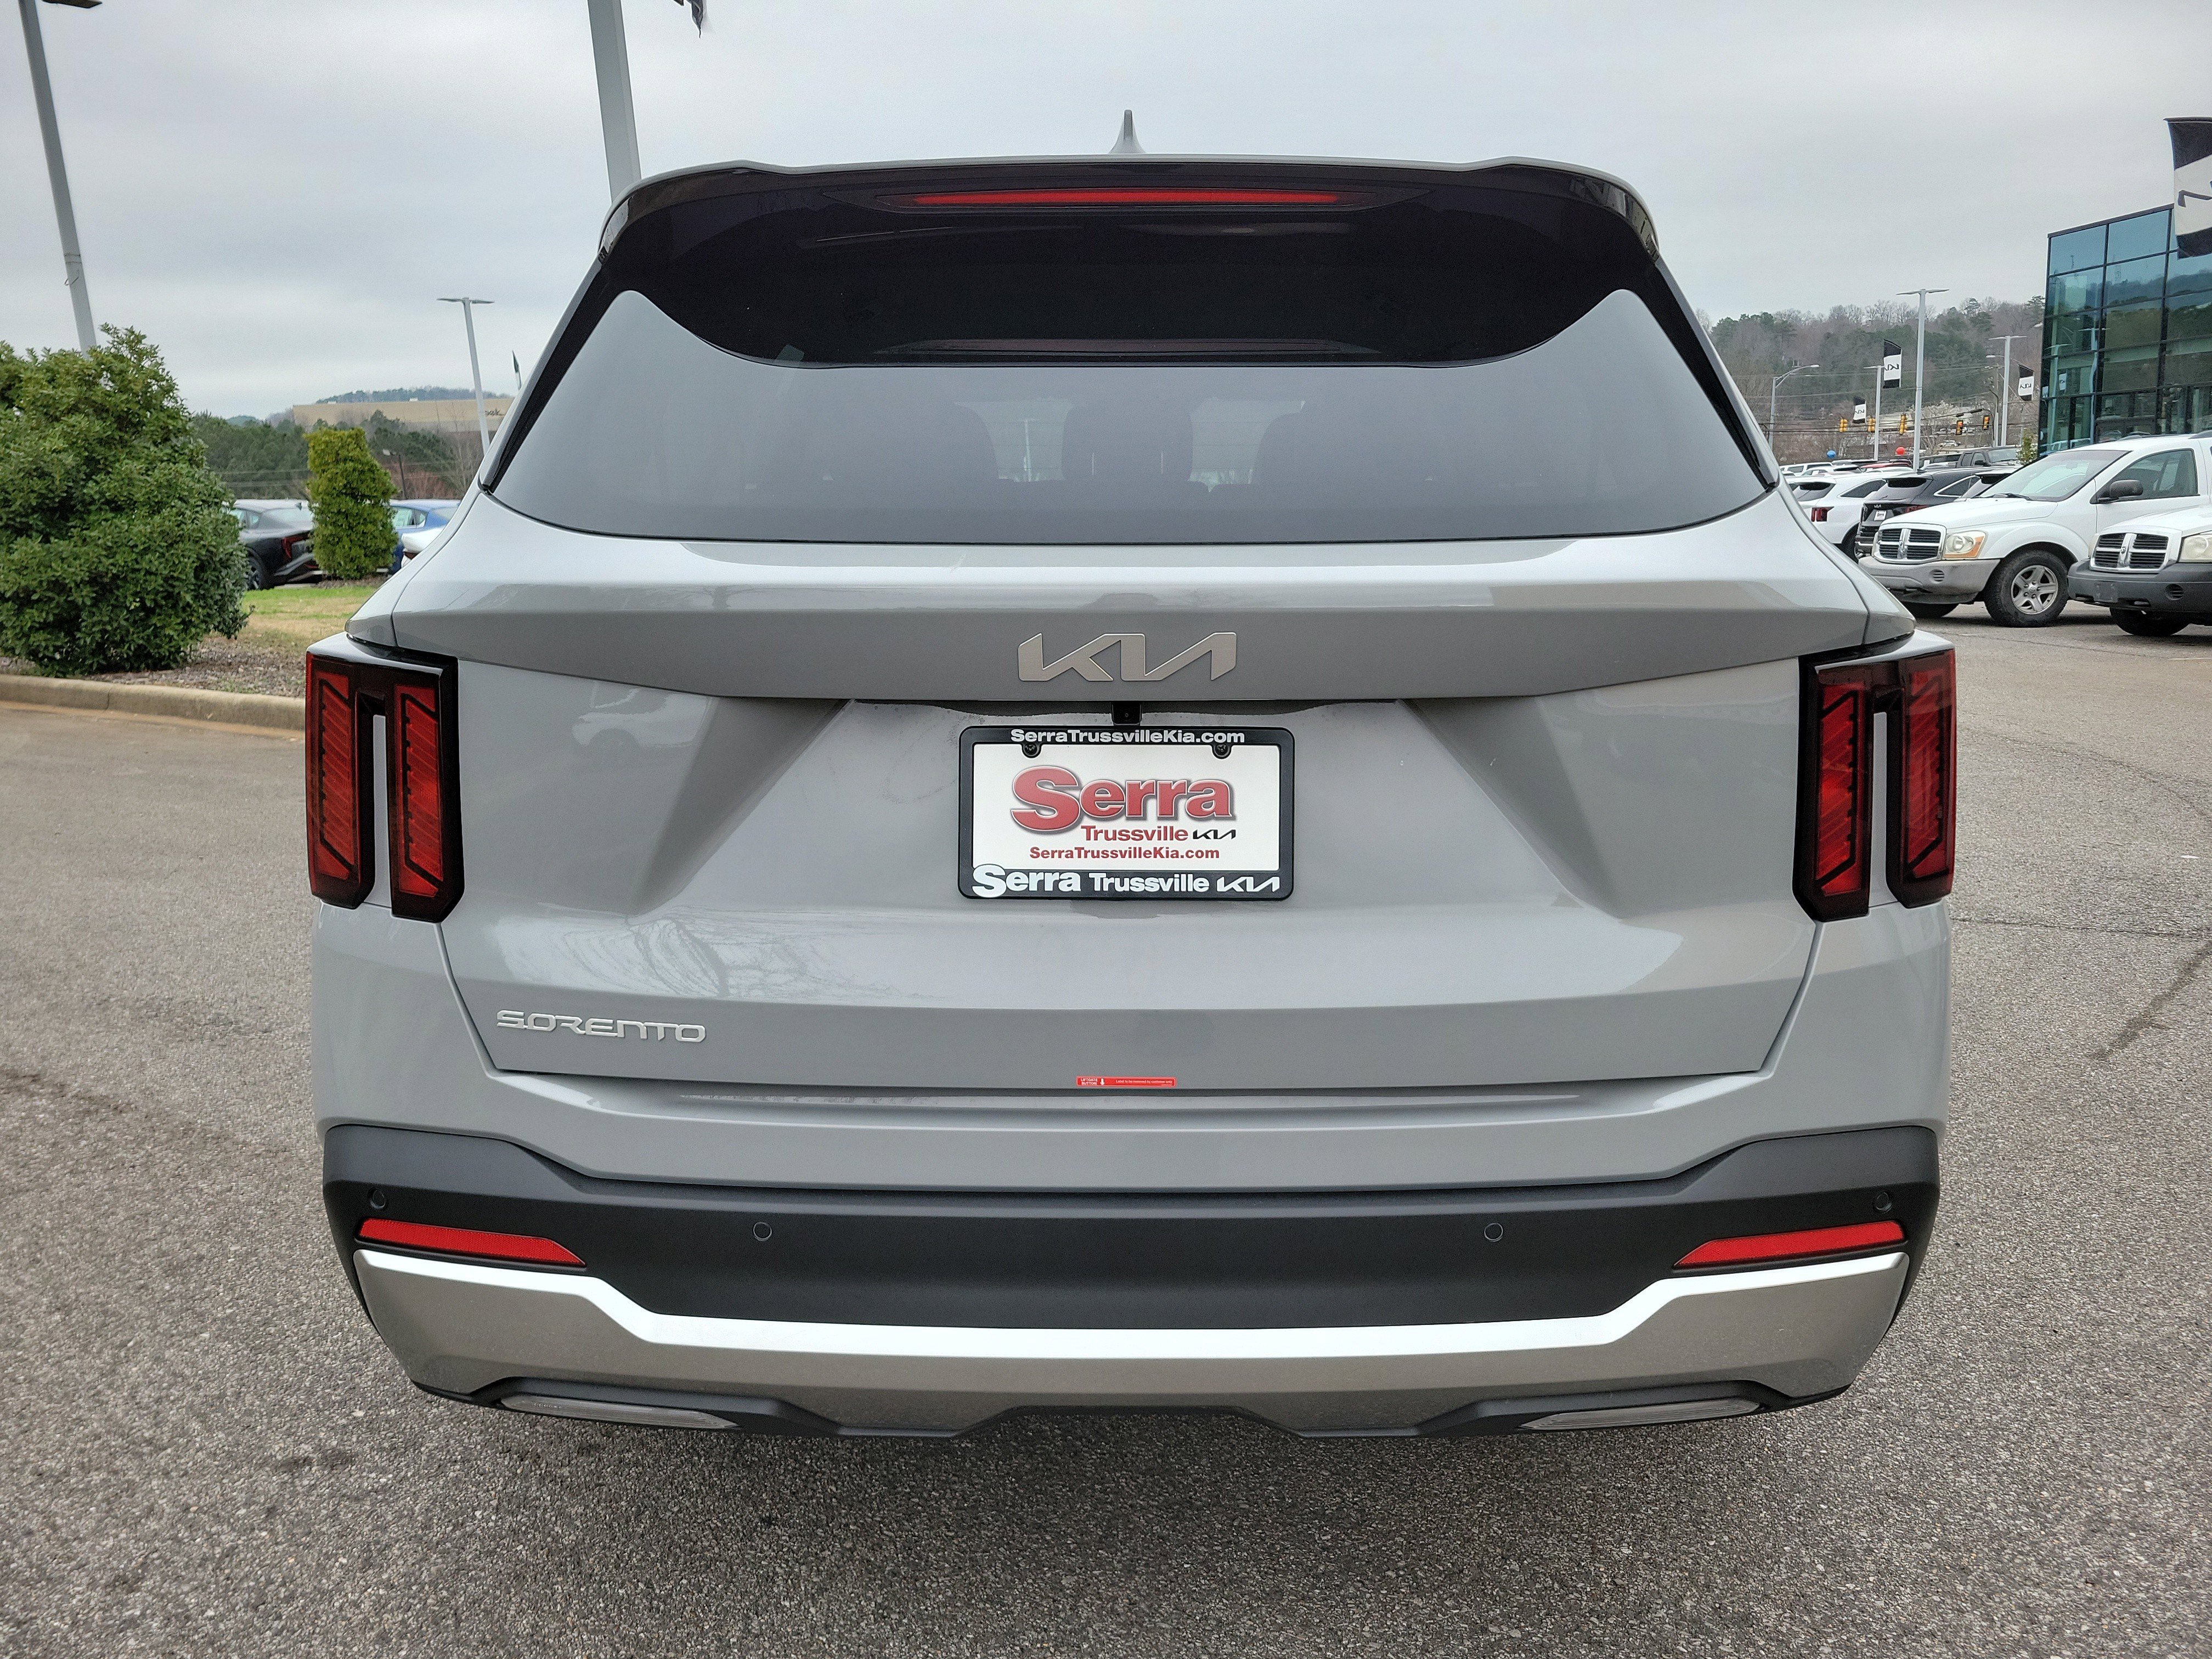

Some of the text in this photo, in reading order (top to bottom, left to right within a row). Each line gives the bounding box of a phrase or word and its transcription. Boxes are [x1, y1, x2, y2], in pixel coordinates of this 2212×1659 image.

[1018, 632, 1237, 681] KIA
[1011, 729, 1245, 743] SerraTrussvilleKia.com
[1011, 766, 1234, 832] Serra
[1080, 826, 1236, 841] Trussville KIA
[1029, 847, 1220, 860] SerraTrussvilleKia.com
[972, 864, 1280, 898] Serra Trussville KIA
[496, 1009, 707, 1042] SORENTO
